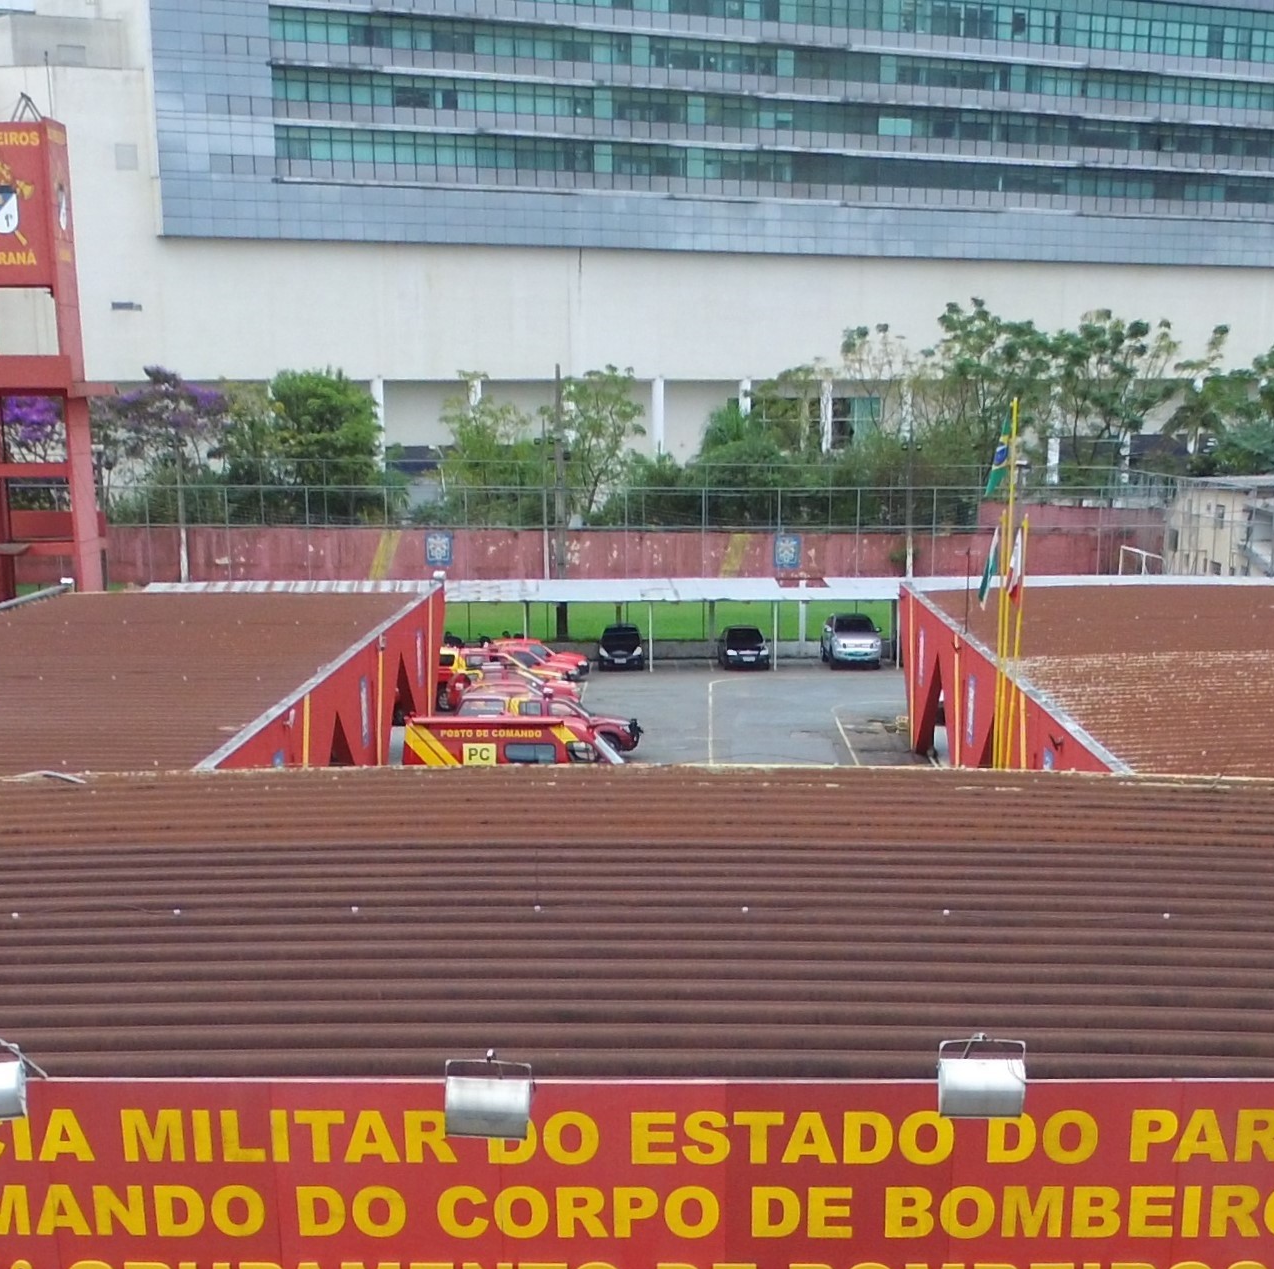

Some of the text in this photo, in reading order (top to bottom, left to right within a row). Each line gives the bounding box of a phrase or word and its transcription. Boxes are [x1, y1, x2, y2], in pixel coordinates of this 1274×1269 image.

[440, 729, 542, 738] POSTO DE COMANDO
[468, 748, 490, 761] PC
[121, 1109, 457, 1163] MILITAR
[488, 1111, 599, 1165] DO
[631, 1110, 954, 1165] ESTADO
[987, 1110, 1098, 1165] DO
[296, 1186, 407, 1238] DO
[436, 1186, 720, 1238] CORPO
[751, 1187, 853, 1238] DE
